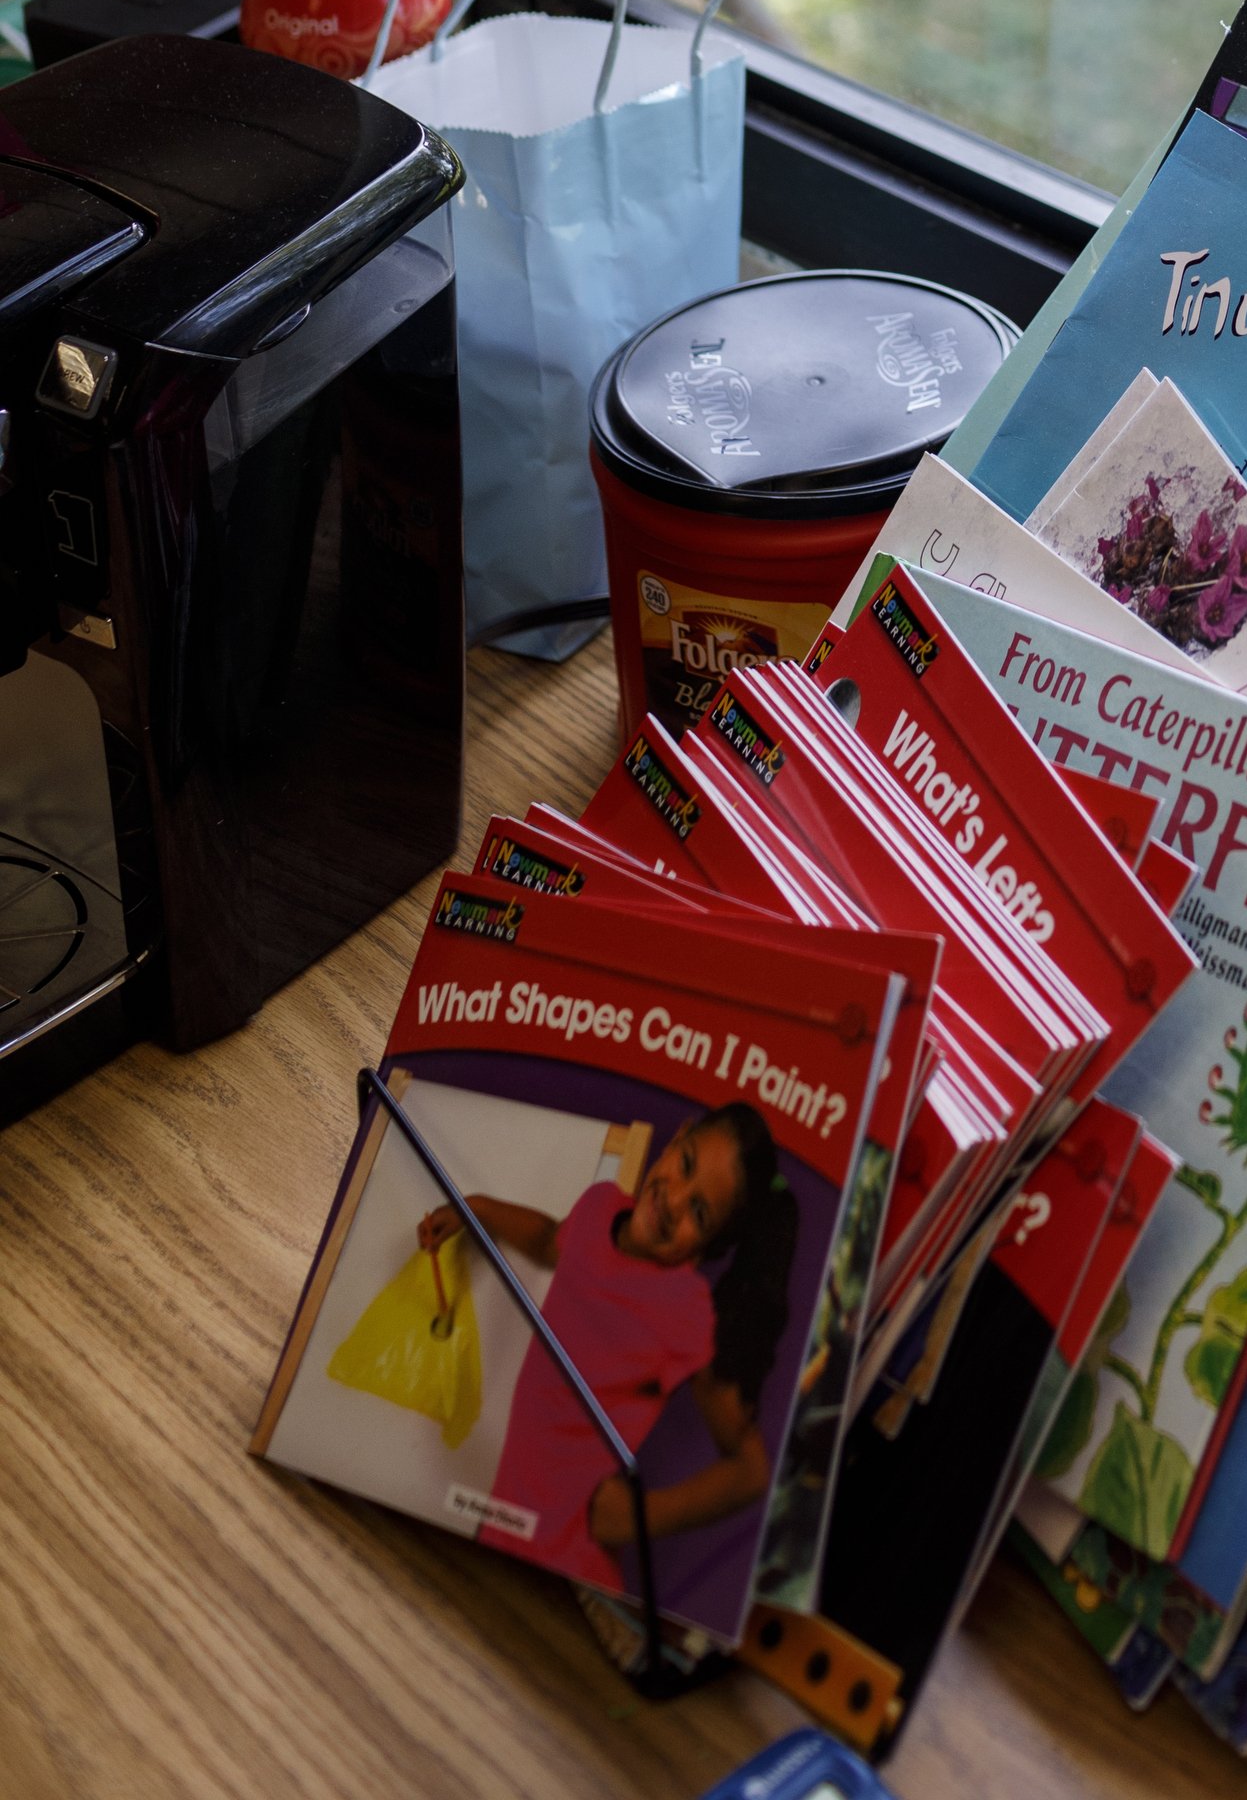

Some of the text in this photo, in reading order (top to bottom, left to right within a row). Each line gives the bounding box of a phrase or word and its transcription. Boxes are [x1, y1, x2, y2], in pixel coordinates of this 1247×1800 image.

[265, 8, 339, 40] Original
[873, 600, 925, 675] LEARNING
[880, 583, 938, 666] Newmark
[999, 632, 1087, 707] From
[710, 709, 774, 784] LEARNING
[716, 692, 783, 773] Newmark
[624, 754, 689, 838] LEARNING
[630, 738, 698, 828] Newmark
[883, 709, 985, 853] What's
[497, 840, 580, 898] Newmark
[434, 911, 516, 941] LEARNING
[440, 890, 522, 930] Newmark
[418, 981, 502, 1025] What
[506, 981, 634, 1041] Shapes
[639, 1007, 713, 1070] Can
[715, 1034, 740, 1080] I
[737, 1044, 847, 1138] Paint?
